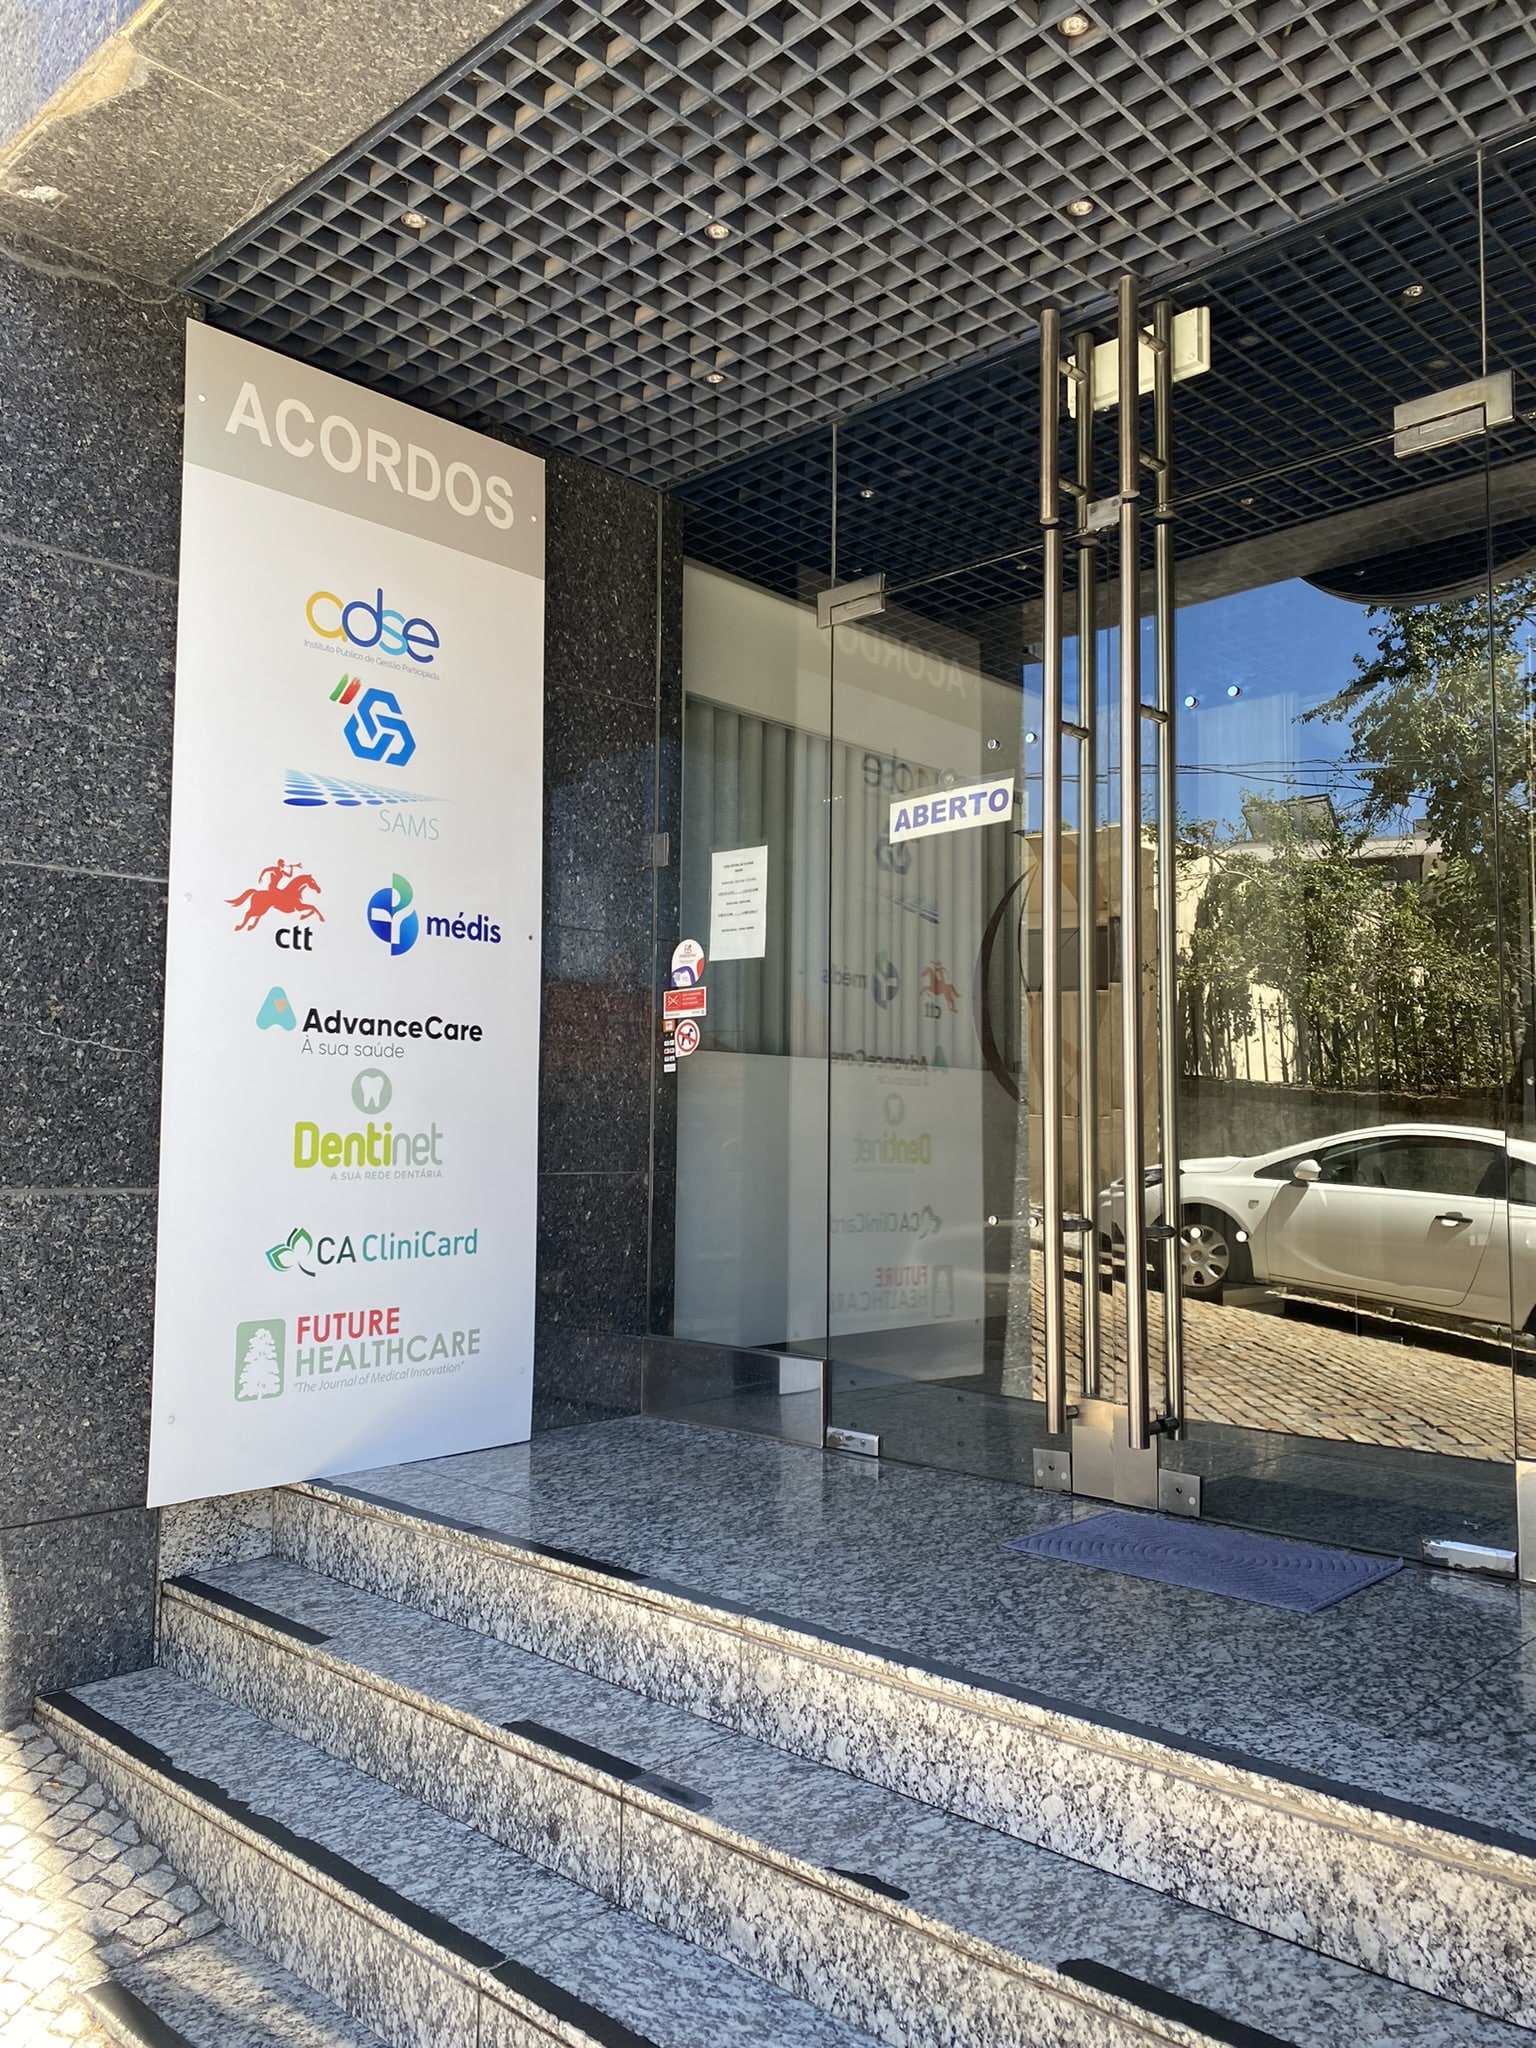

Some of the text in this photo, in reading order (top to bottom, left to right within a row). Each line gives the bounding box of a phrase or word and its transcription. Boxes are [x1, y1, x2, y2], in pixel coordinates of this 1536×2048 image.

[225, 381, 514, 530] ACORDOS
[306, 588, 440, 663] adse
[304, 639, 440, 681] Instituto Público de Gestão Participada
[378, 809, 440, 841] SAMS
[894, 788, 1009, 832] ABERTO
[275, 926, 313, 951] ctt
[426, 912, 502, 944] médis
[302, 1007, 483, 1042] AdvanceCare
[301, 1034, 405, 1058] À sua saúde
[293, 1121, 443, 1169] Dentinet
[330, 1168, 443, 1181] A SUA REDE DENTÁRIA
[317, 1227, 478, 1265] CA CliniCard
[296, 1307, 400, 1345] FUTURE
[295, 1328, 480, 1378] HEALTHCARE
[318, 1376, 357, 1391] Journal
[359, 1375, 370, 1386] of
[370, 1368, 409, 1384] Medical
